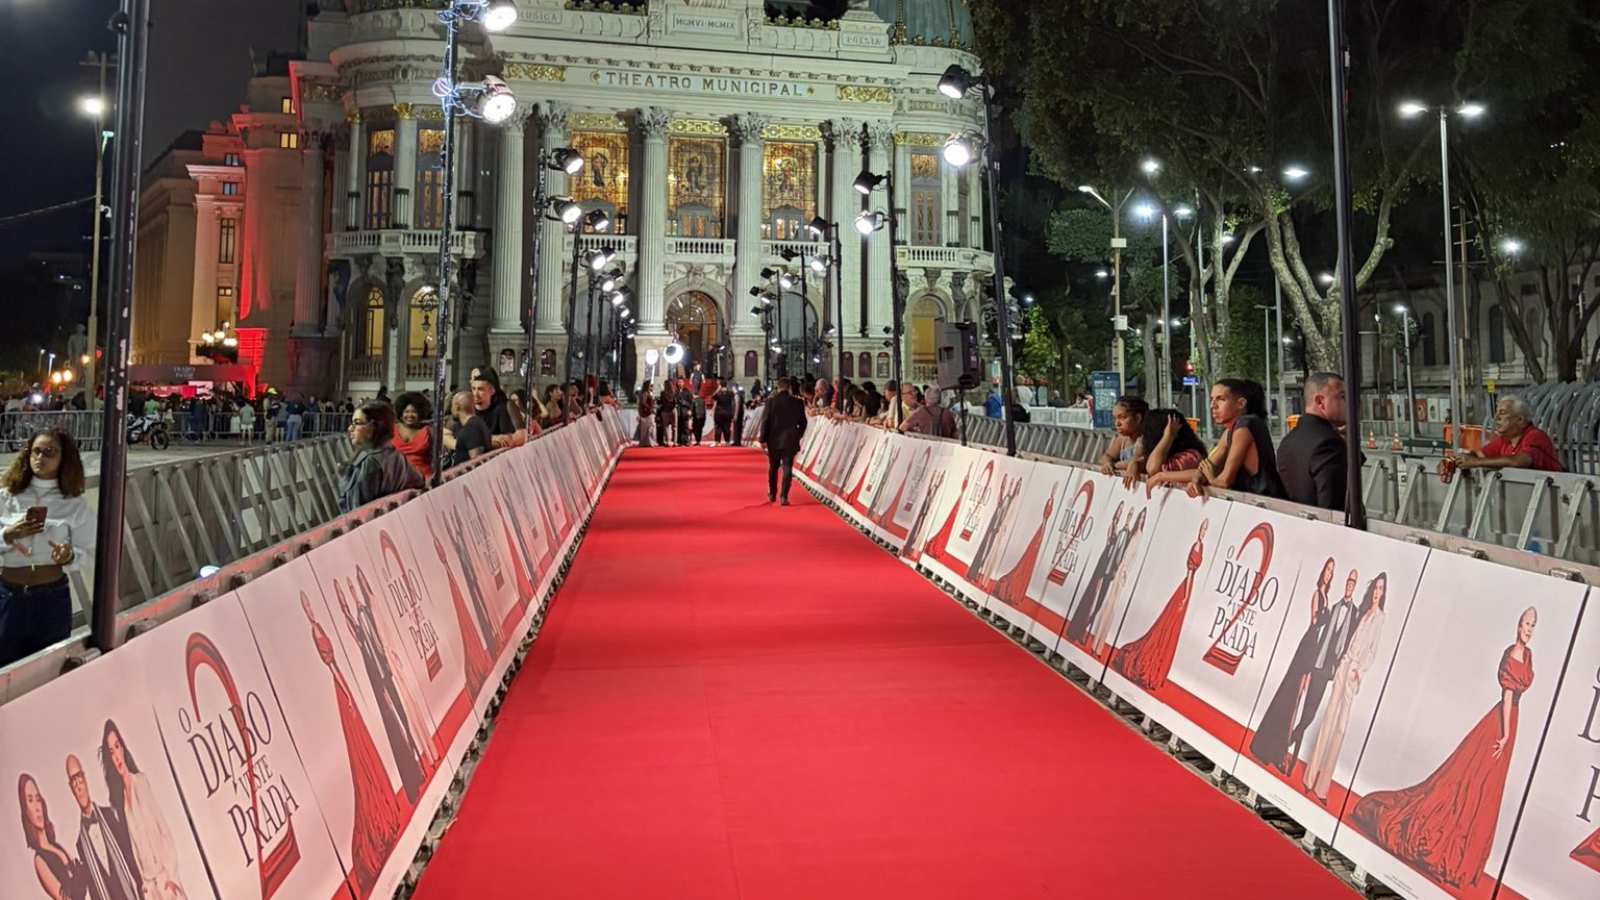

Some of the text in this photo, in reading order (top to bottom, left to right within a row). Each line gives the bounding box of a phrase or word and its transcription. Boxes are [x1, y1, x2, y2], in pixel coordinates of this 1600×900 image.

[606, 71, 802, 97] THEATRO MUNICIPAL
[1216, 560, 1279, 612] DIABO
[1208, 606, 1258, 659] PRADA
[178, 707, 192, 734] O
[187, 691, 272, 798] DIABO
[228, 774, 299, 868] PRADA
